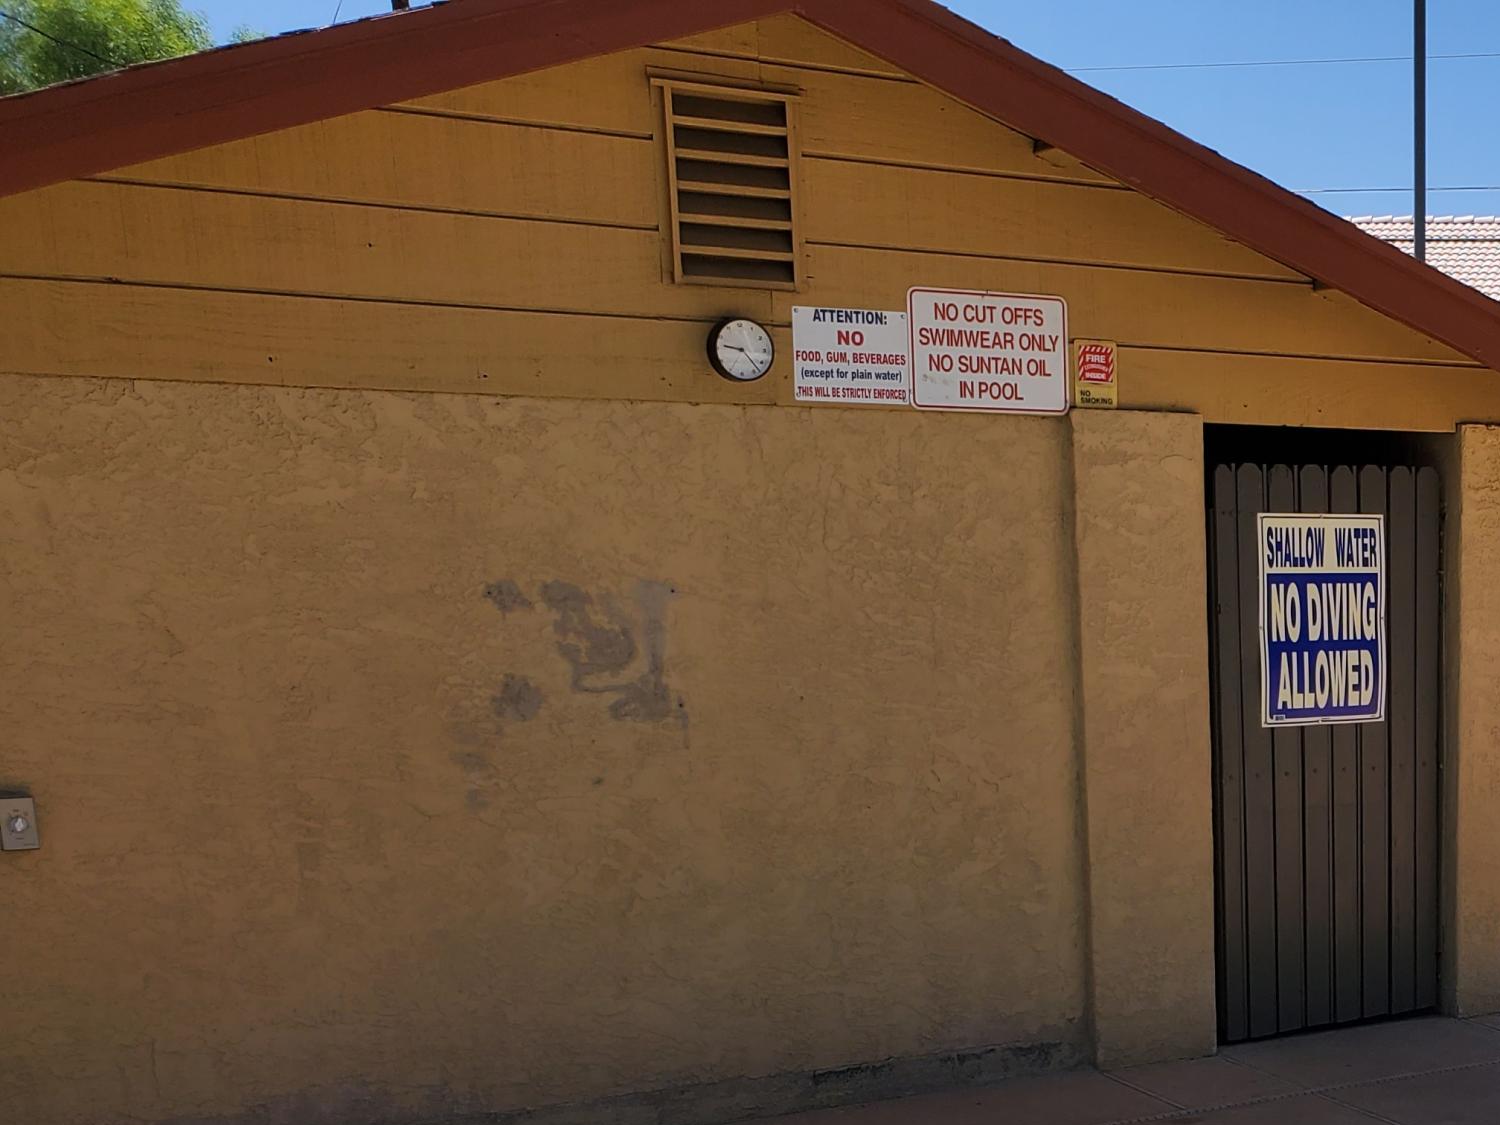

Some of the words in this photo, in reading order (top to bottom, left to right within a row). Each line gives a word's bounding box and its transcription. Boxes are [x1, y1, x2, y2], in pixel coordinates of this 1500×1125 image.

[813, 309, 887, 325] ATTENTION:
[934, 302, 959, 321] NO
[963, 304, 997, 324] CUT
[1001, 306, 1044, 327] OFFS
[837, 330, 865, 346] NO
[919, 327, 1014, 350] SWIMWEAR
[1019, 333, 1059, 353] ONLY
[795, 350, 824, 365] FOOD,
[826, 352, 850, 366] GUM,
[852, 353, 906, 366] BEVERAGES
[928, 353, 953, 373] NO
[958, 355, 1022, 376] SUNTAN
[1027, 358, 1052, 377] OIL
[1086, 354, 1106, 364] FIRE
[801, 367, 834, 380] (except
[836, 368, 848, 379] for
[851, 369, 873, 381] plain
[875, 370, 902, 383] water)
[797, 386, 813, 397] THIS
[815, 386, 830, 397] WILL
[832, 387, 840, 397] BE
[842, 388, 872, 398] STRICTLY
[873, 389, 907, 400] ENFORCED
[959, 380, 974, 399] IN
[978, 381, 1024, 401] POOL
[1080, 396, 1113, 405] SMOKING
[1267, 526, 1325, 568] SHALLOW
[1334, 527, 1377, 568] WATER
[1271, 582, 1301, 643] NO
[1306, 581, 1376, 642] DIVING
[1277, 649, 1374, 710] ALLOWED
